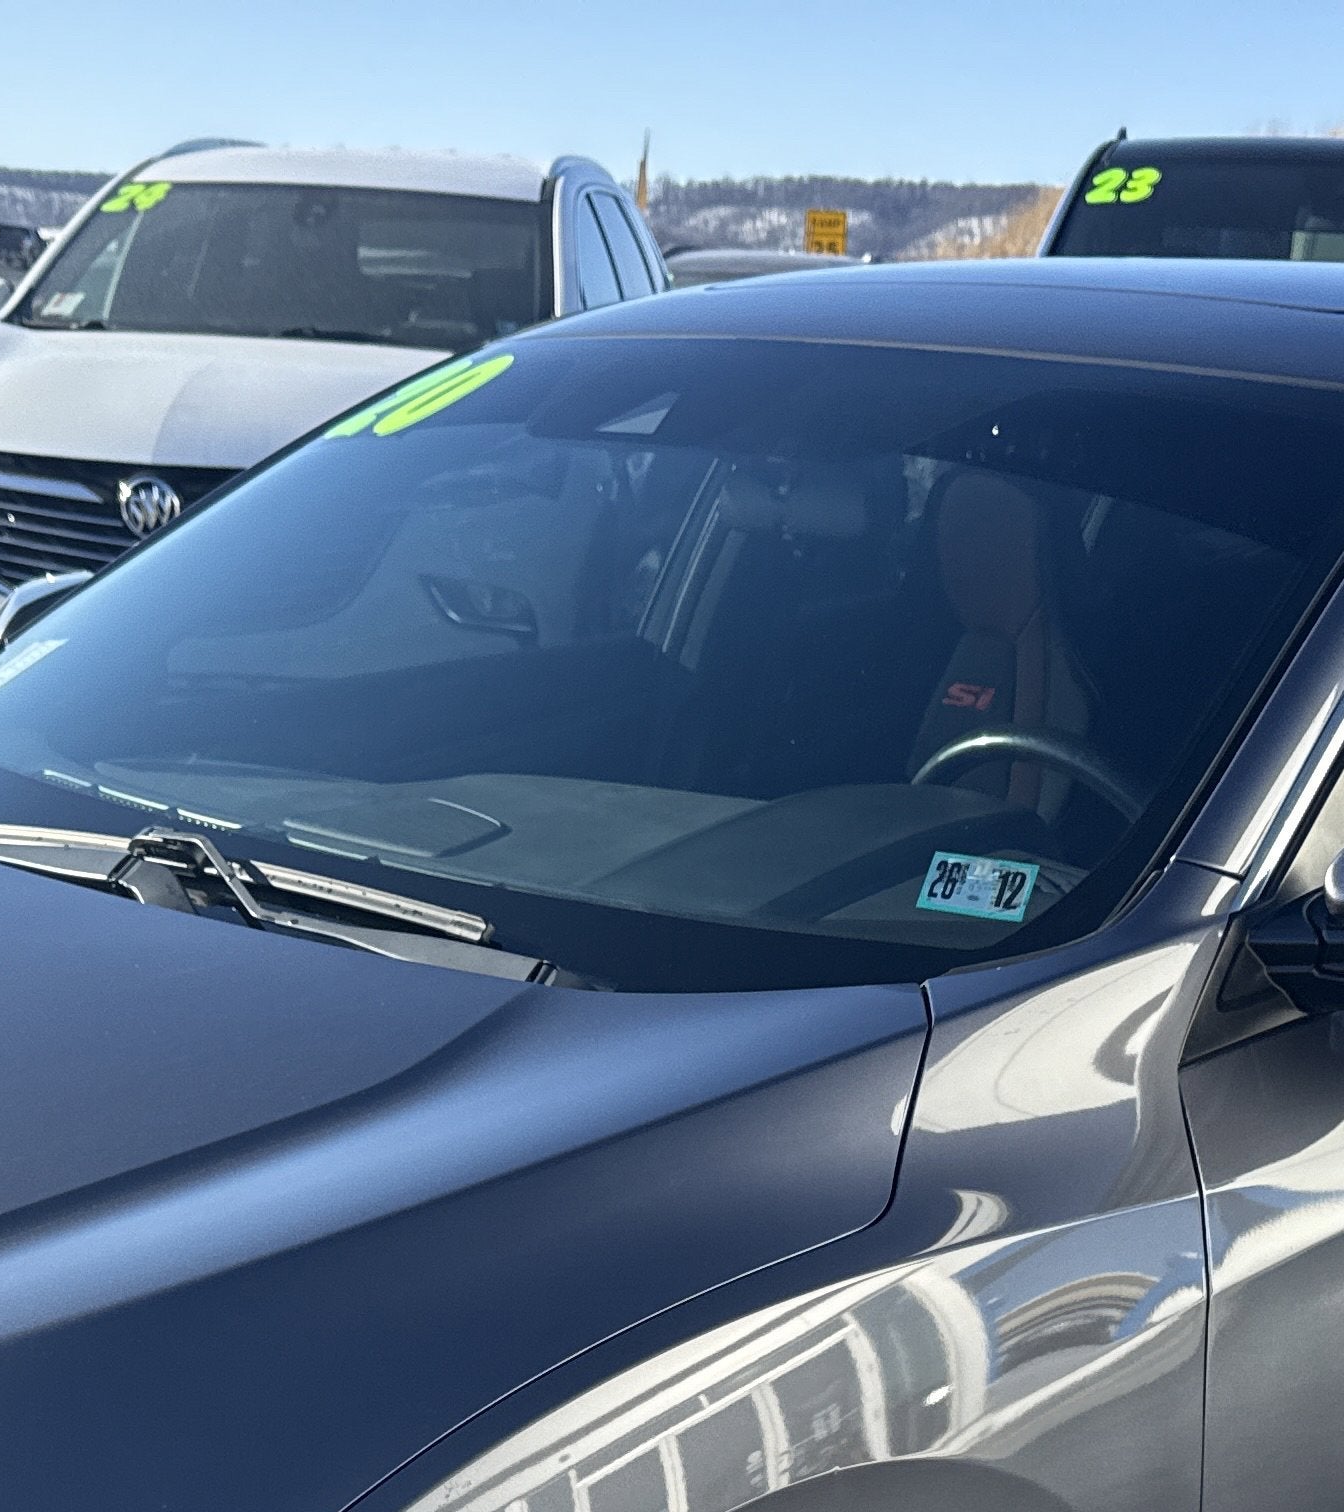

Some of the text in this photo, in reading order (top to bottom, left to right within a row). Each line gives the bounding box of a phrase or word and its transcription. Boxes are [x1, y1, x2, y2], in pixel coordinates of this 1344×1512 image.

[1084, 167, 1162, 204] 23
[927, 860, 963, 899] 26
[993, 870, 1027, 910] 12
